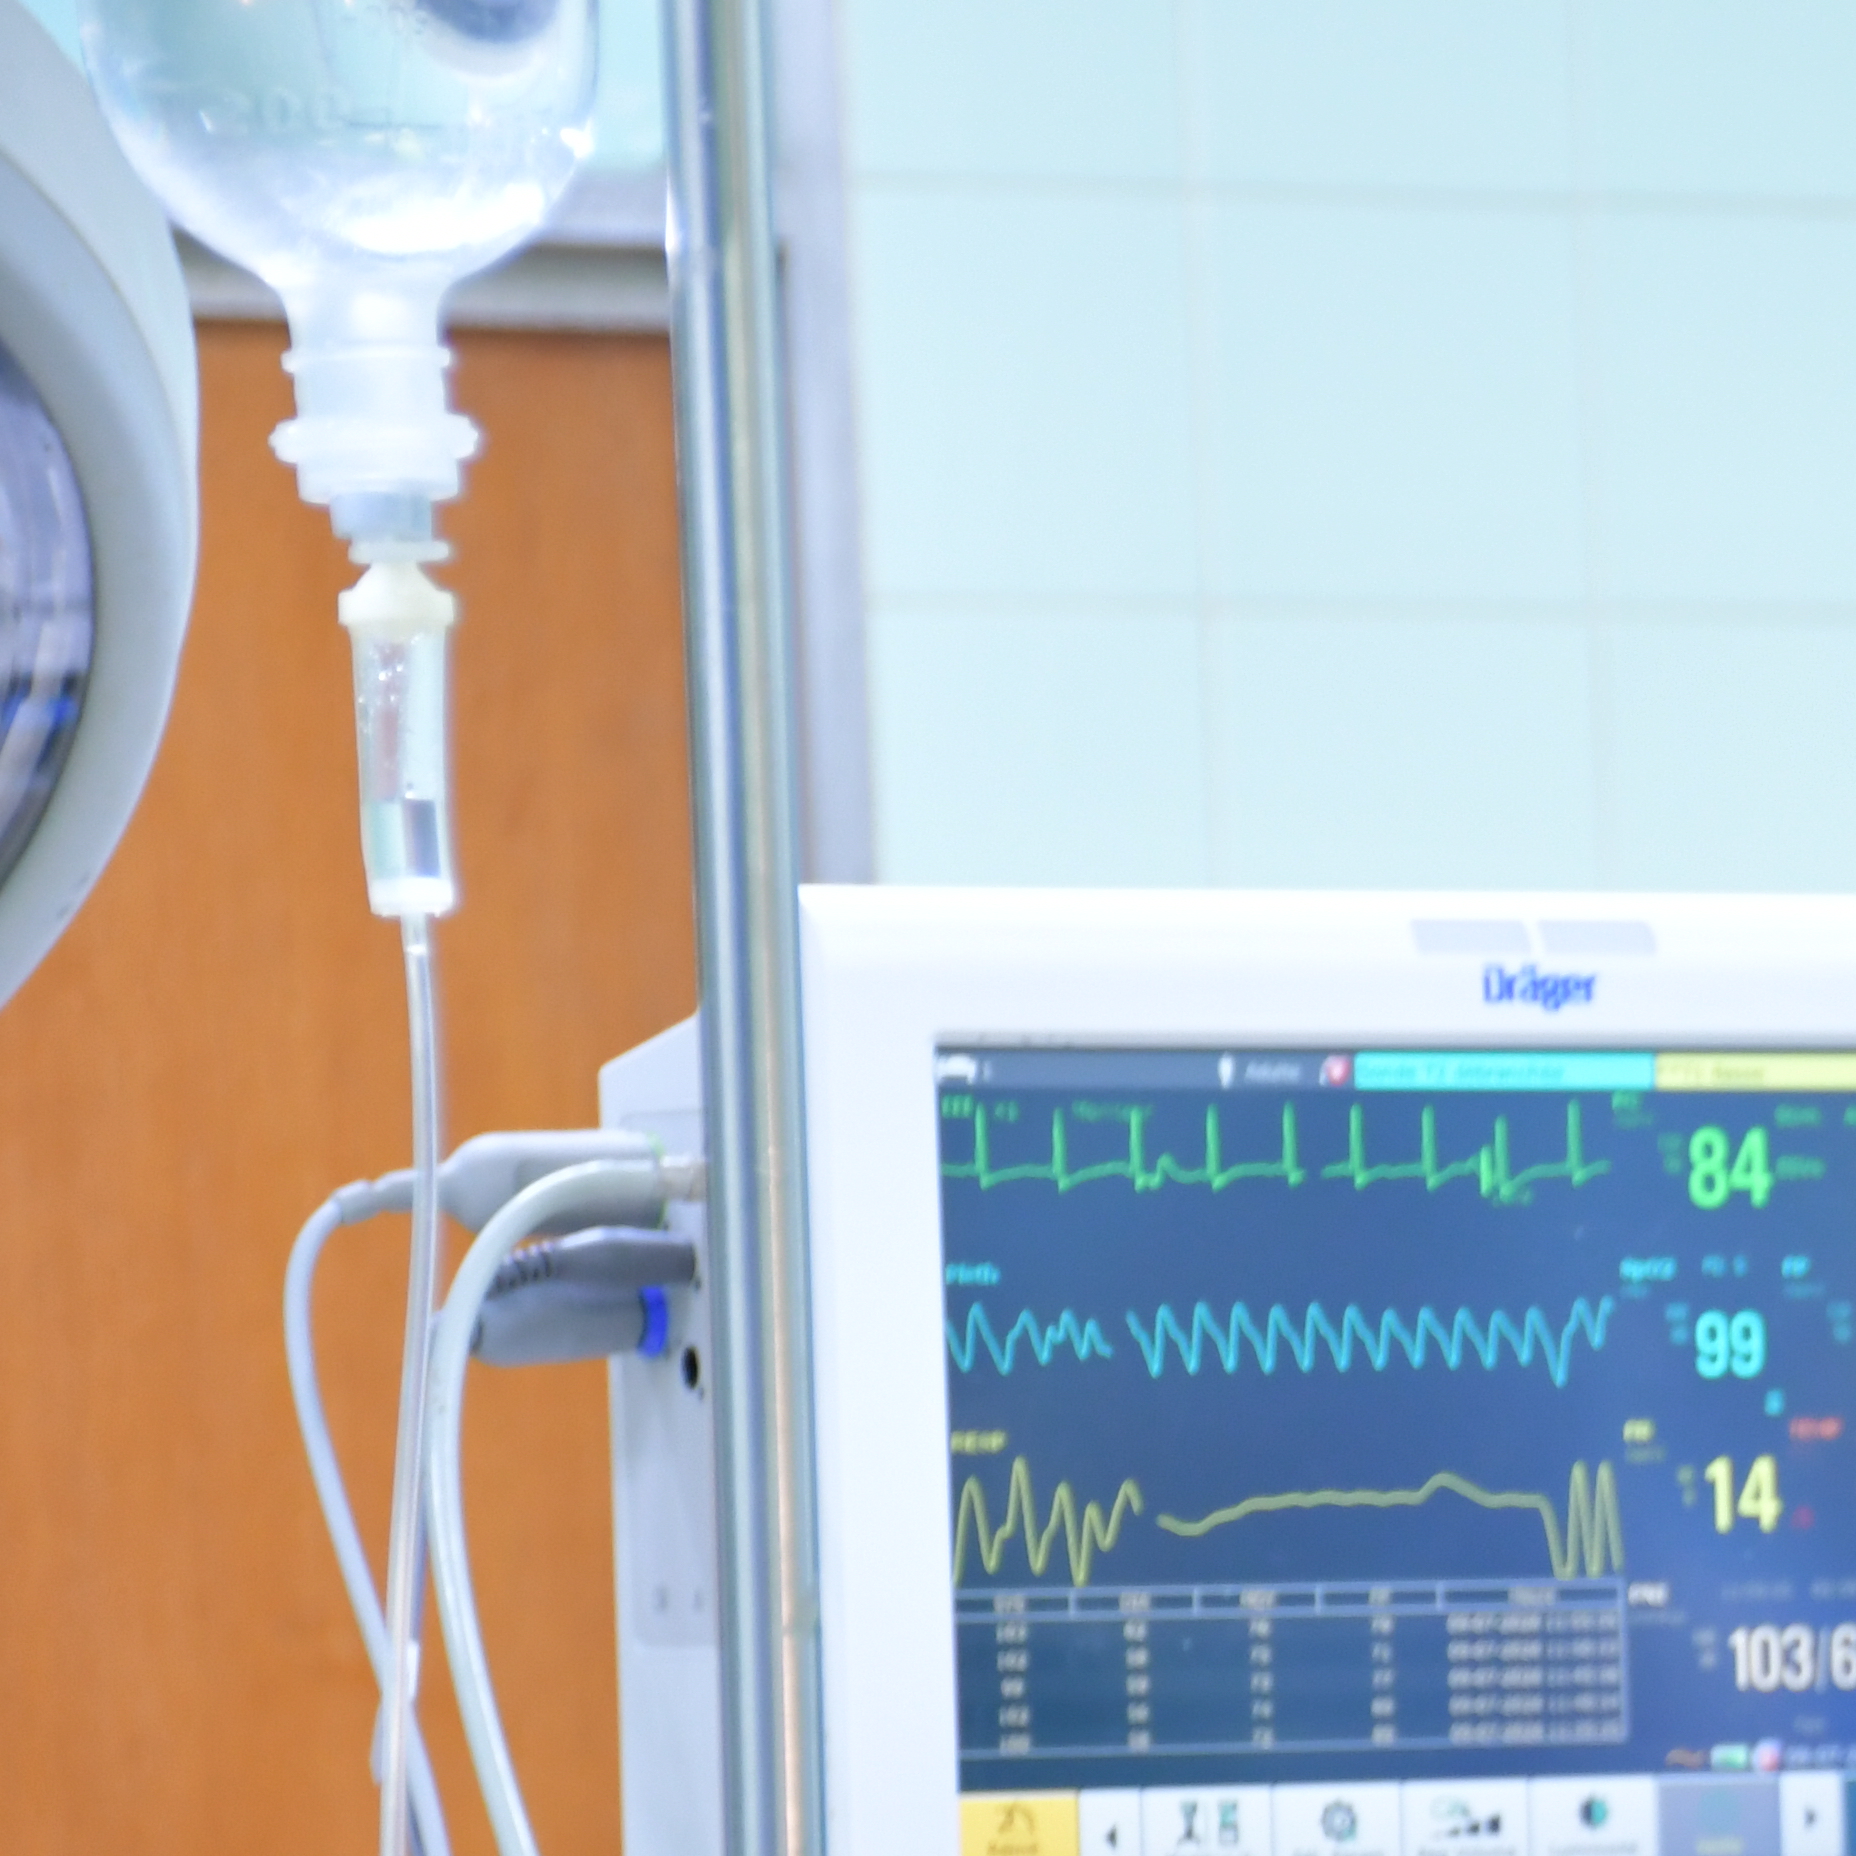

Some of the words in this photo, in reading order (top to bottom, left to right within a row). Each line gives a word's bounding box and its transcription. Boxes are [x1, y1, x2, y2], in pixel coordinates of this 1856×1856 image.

[1483, 964, 1597, 1012] Dräger
[1688, 1126, 1775, 1209] 84
[1695, 1309, 1767, 1379] 99
[1704, 1454, 1783, 1534] 14
